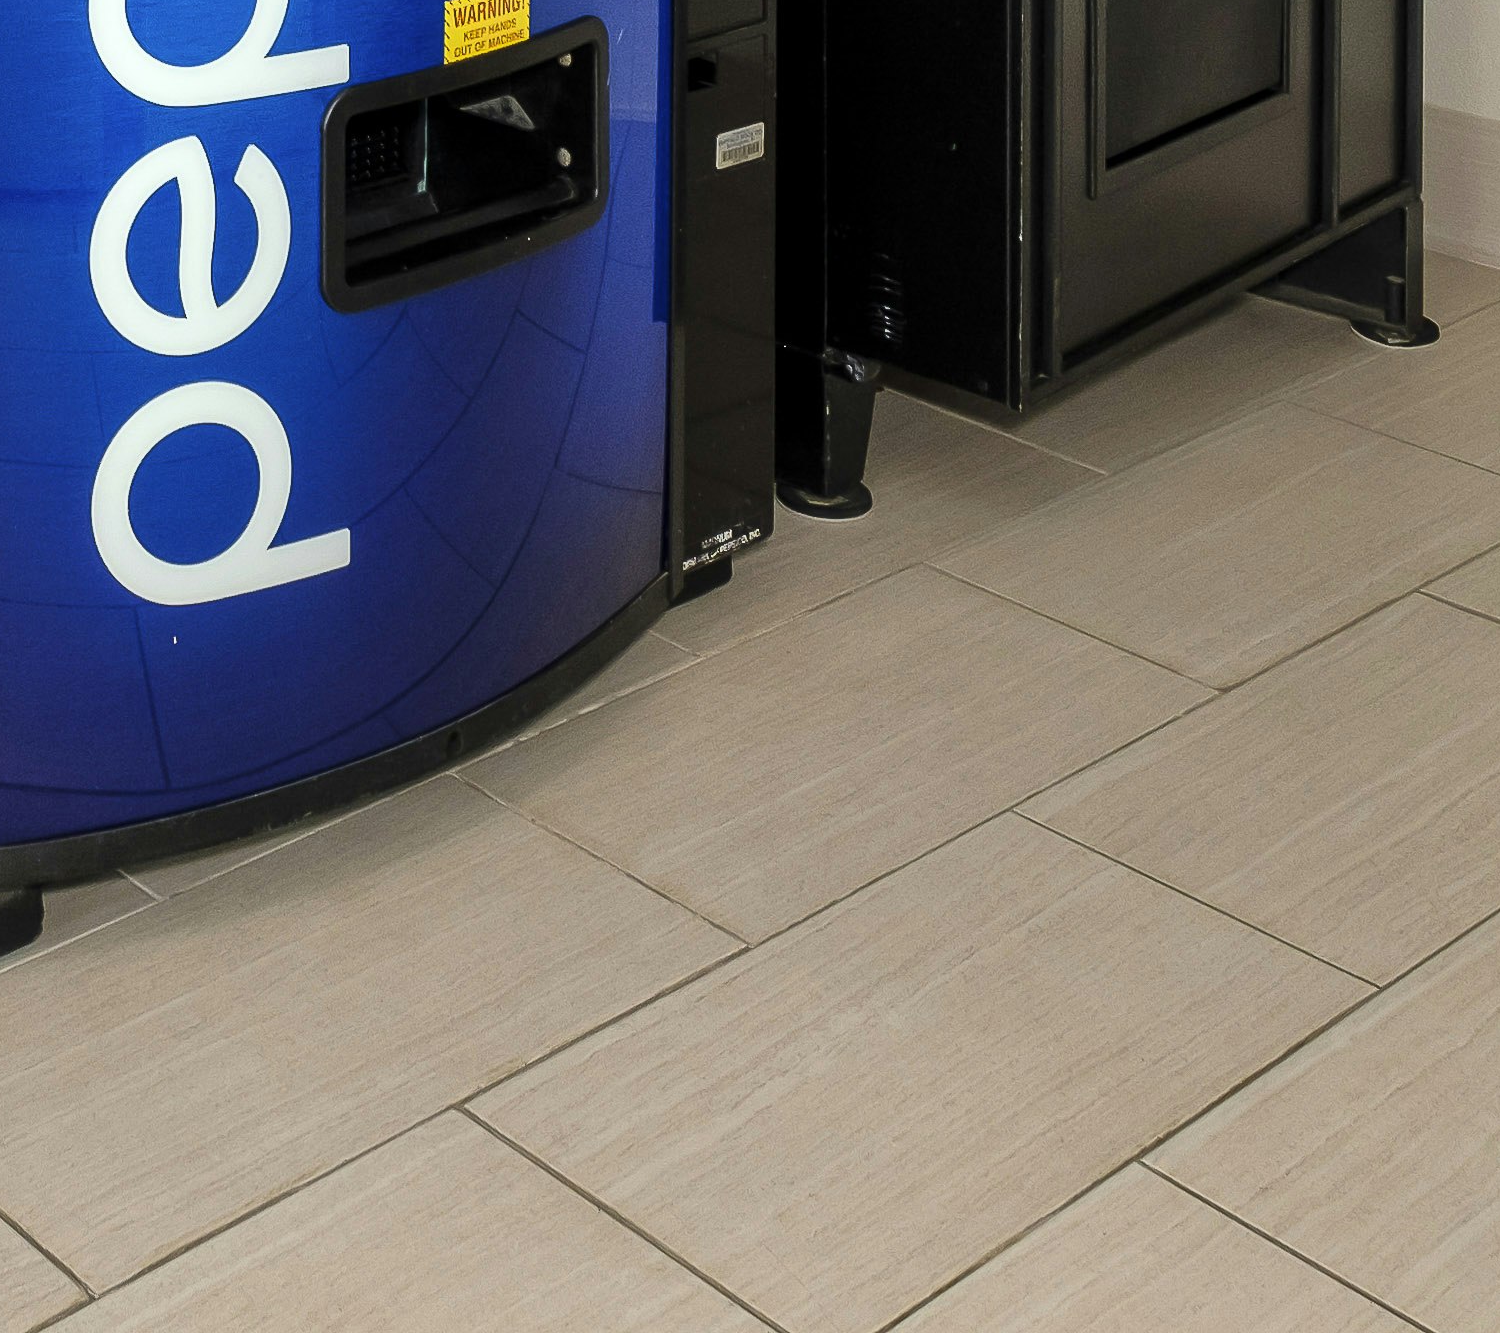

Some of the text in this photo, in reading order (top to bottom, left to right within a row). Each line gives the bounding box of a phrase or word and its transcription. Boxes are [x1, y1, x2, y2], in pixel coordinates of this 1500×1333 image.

[453, 28, 525, 58] OUT OF MACHINE
[463, 18, 517, 42] KEEP HANDS
